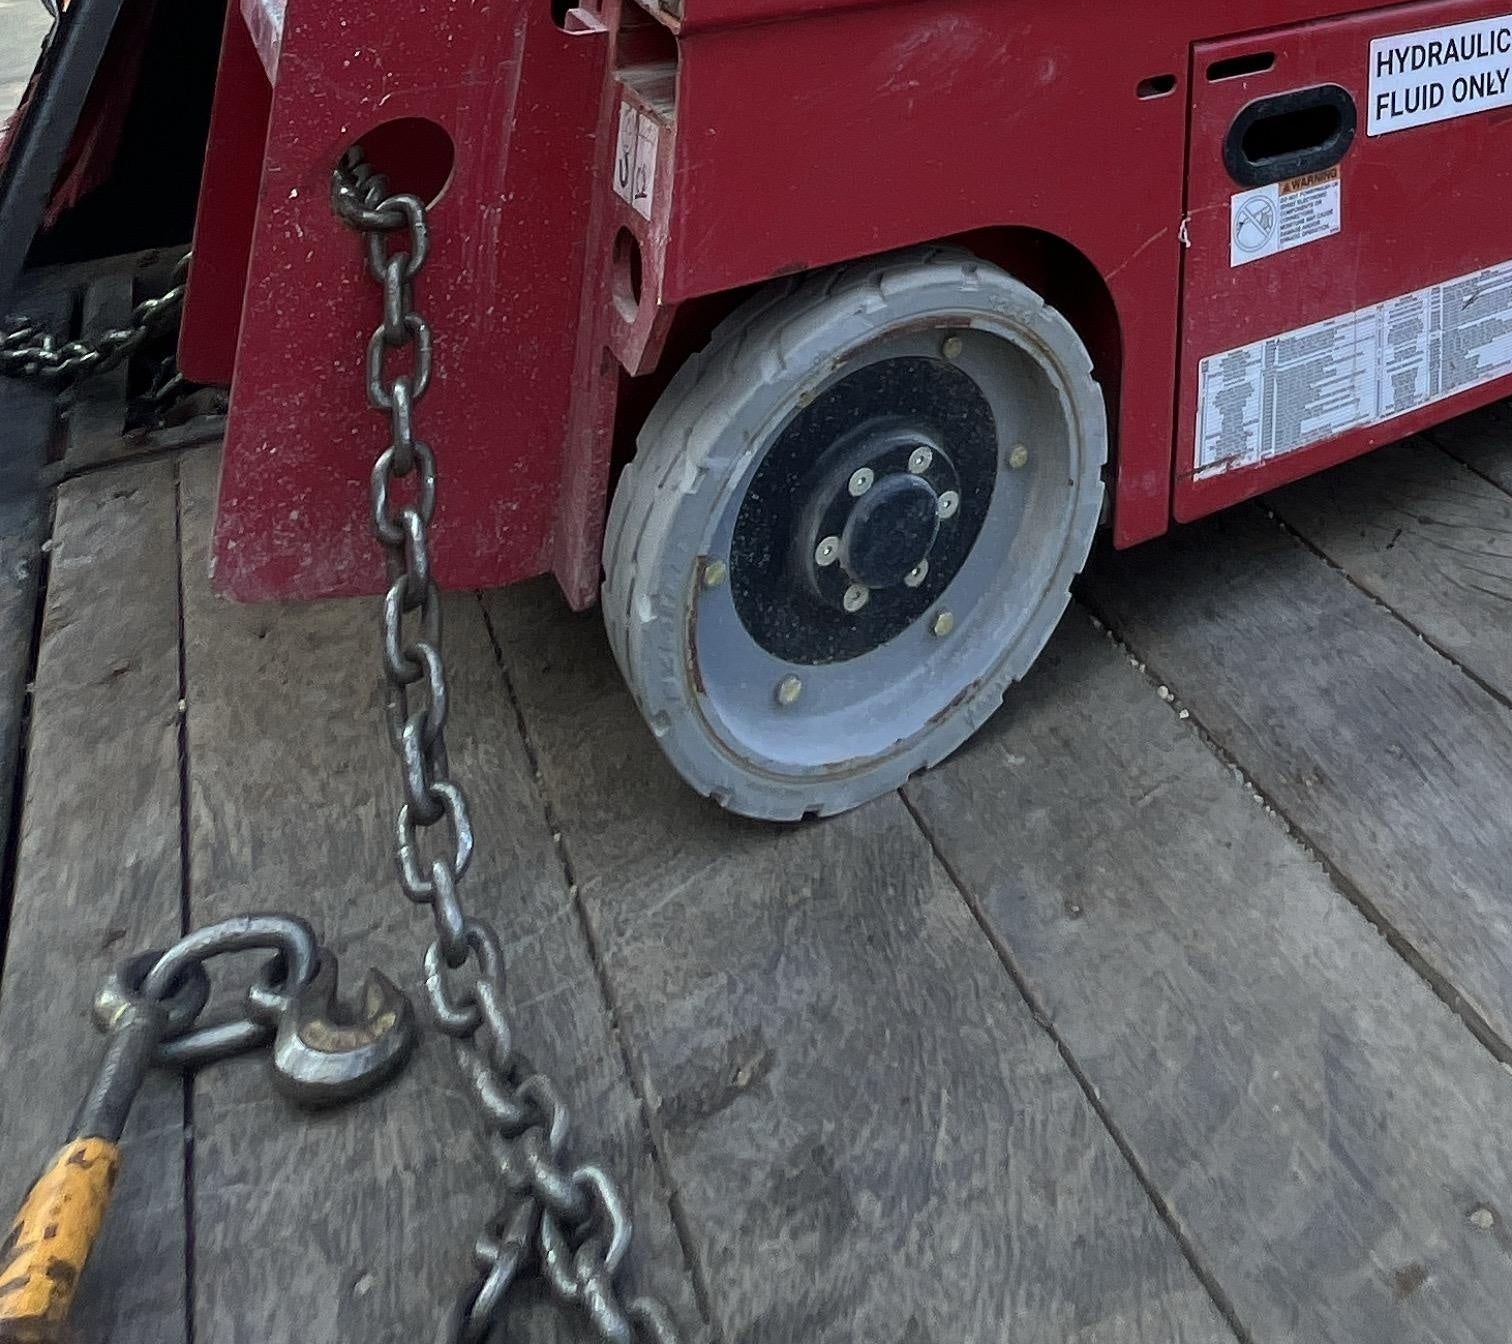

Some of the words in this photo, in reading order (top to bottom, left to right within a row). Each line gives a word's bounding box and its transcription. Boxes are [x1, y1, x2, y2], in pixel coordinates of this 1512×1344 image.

[1375, 26, 1512, 77] HYDRAULIC
[1375, 82, 1444, 121] FLUID
[1451, 68, 1510, 109] ONLY
[1291, 168, 1337, 190] WARNING
